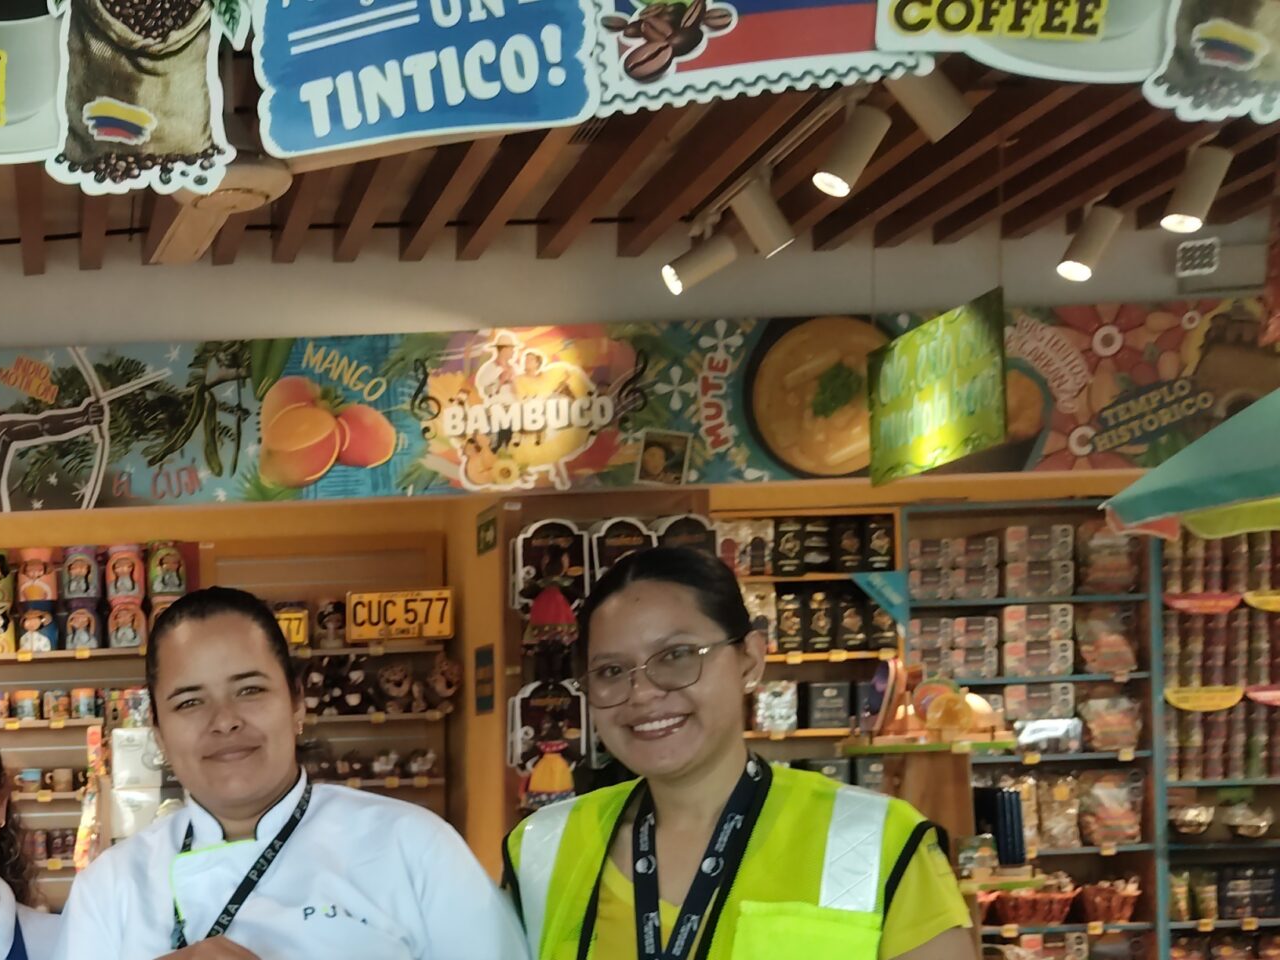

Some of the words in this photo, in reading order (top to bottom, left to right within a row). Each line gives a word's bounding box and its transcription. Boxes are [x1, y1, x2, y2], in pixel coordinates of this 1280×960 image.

[894, 0, 1099, 35] COFFEE
[300, 23, 567, 138] TINTICO!
[300, 341, 388, 402] MANGO
[442, 395, 614, 437] BAMBUCO
[702, 354, 732, 451] MUTE
[1100, 379, 1191, 428] TEMPLO
[352, 599, 397, 628] CUC
[403, 596, 450, 626] 577
[248, 838, 284, 882] PURA
[209, 902, 240, 936] URA
